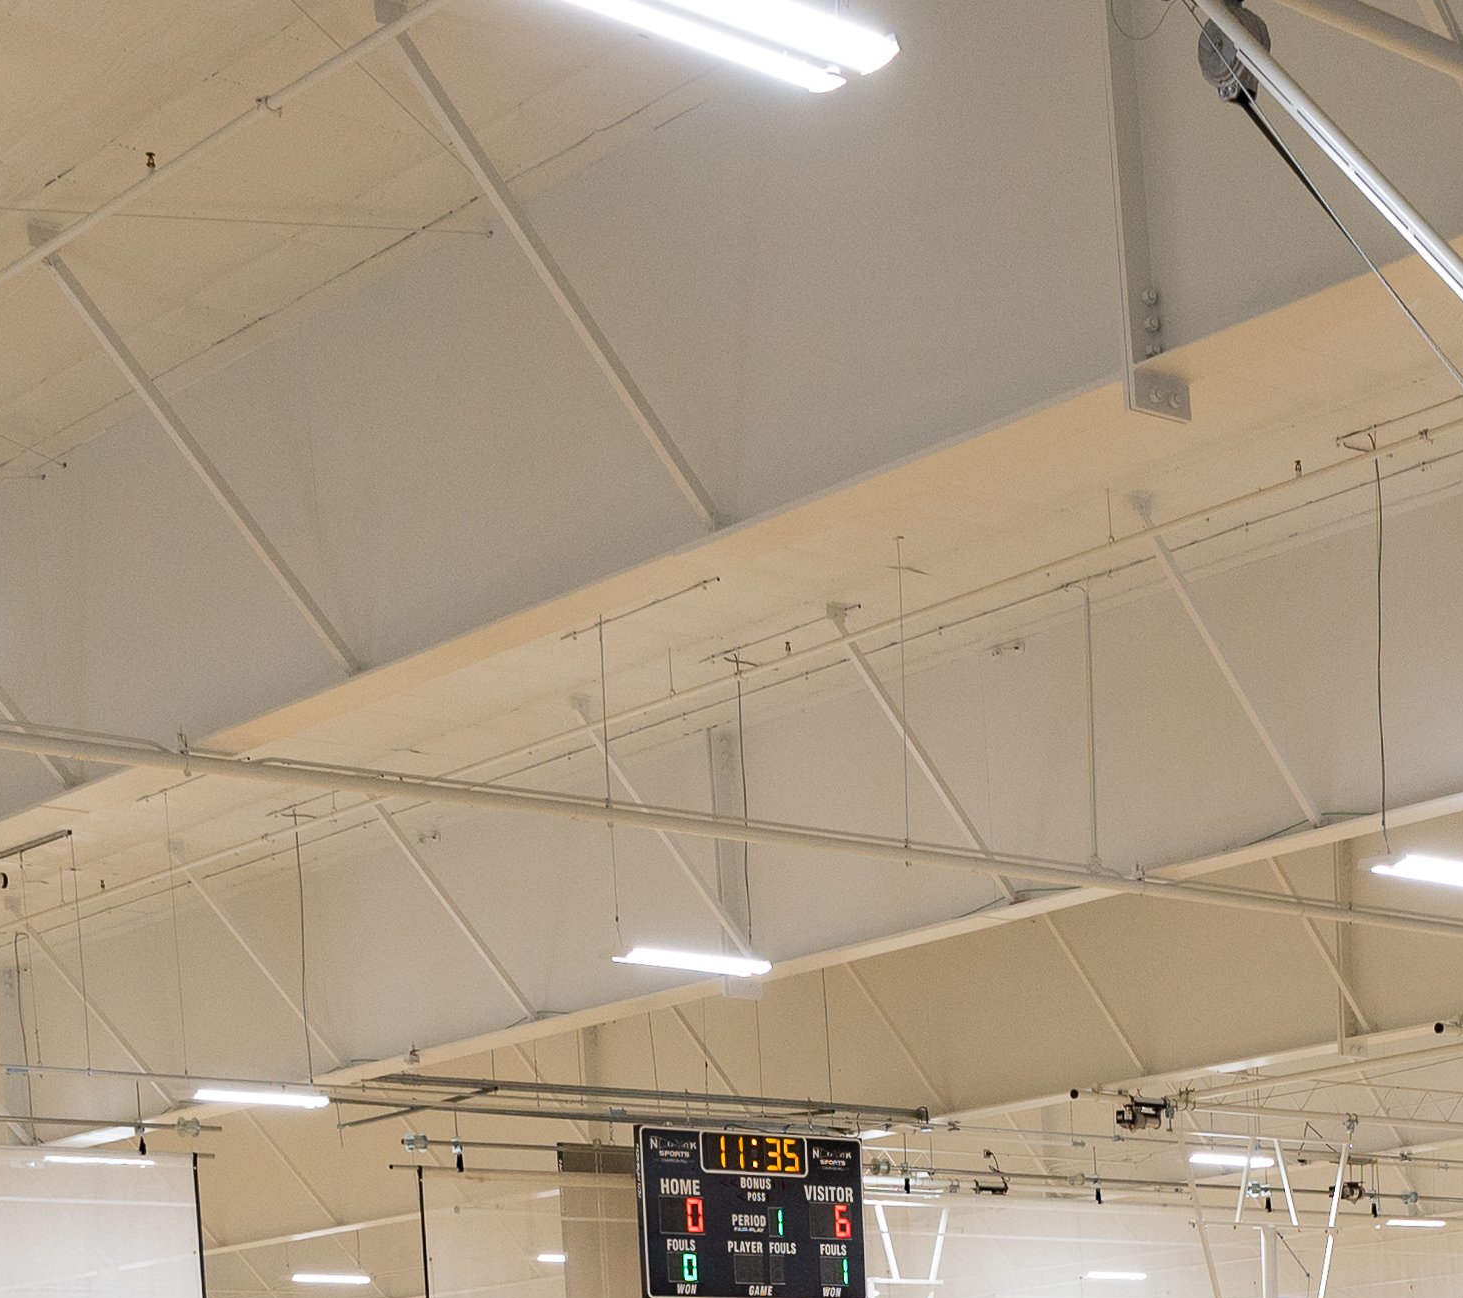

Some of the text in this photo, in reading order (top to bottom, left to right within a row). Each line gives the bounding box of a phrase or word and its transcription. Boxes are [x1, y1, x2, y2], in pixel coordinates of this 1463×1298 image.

[720, 1135, 800, 1173] 11:35
[660, 1178, 701, 1195] HOME
[740, 1176, 772, 1189] BONUS
[747, 1192, 766, 1202] POSS
[804, 1185, 854, 1203] VISITOR
[686, 1197, 704, 1233] 0
[731, 1213, 767, 1227] PERIOD
[834, 1204, 852, 1239] 6
[777, 1209, 784, 1236] 1
[667, 1239, 696, 1252] FOULS
[727, 1241, 797, 1255] PLAYER FOULS
[820, 1244, 847, 1256] FOULS
[682, 1253, 699, 1282] 0
[842, 1258, 849, 1285] 1
[676, 1283, 698, 1295] WON
[748, 1285, 774, 1296] GAME
[822, 1286, 842, 1298] WON
